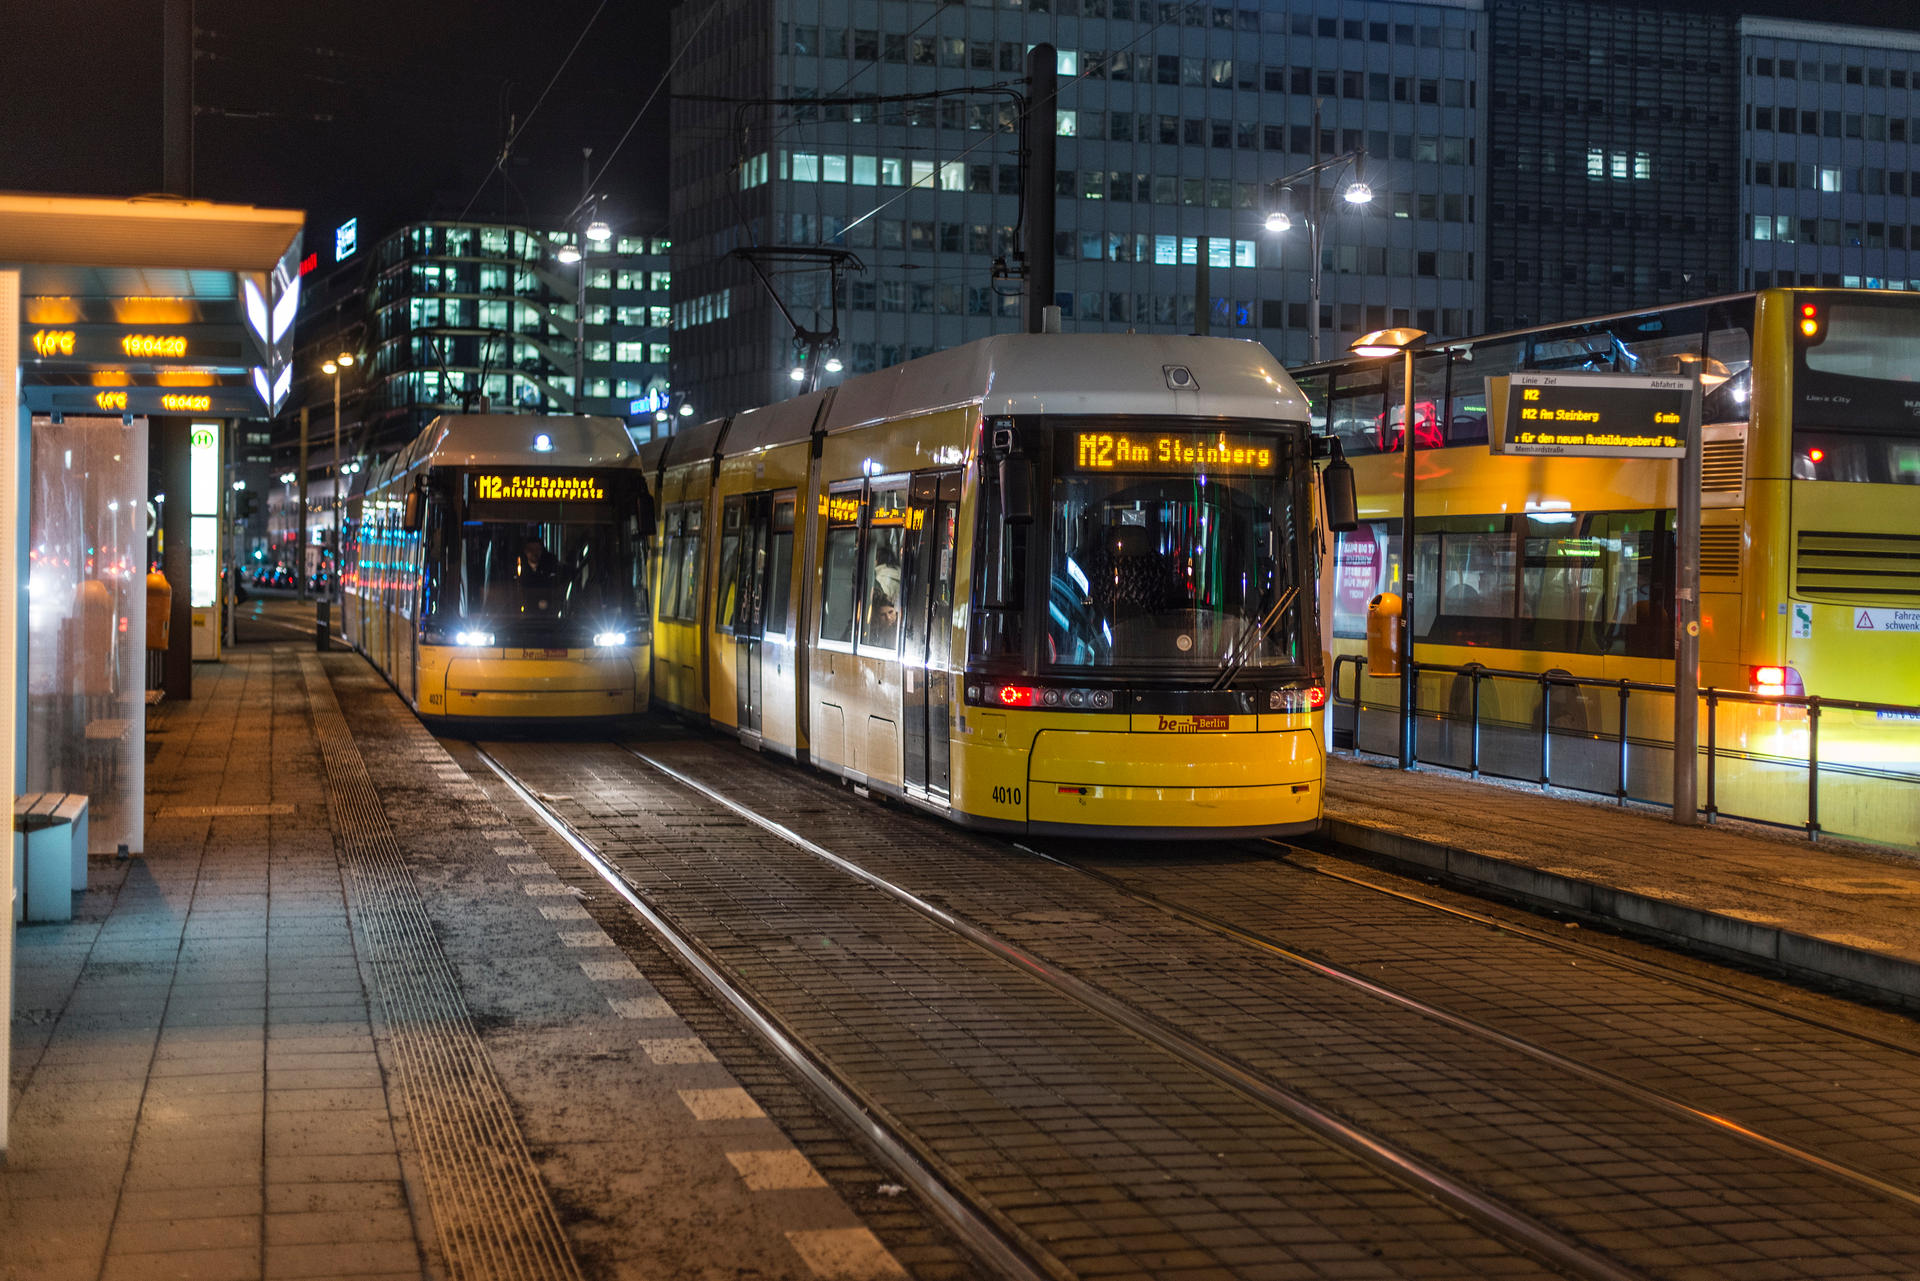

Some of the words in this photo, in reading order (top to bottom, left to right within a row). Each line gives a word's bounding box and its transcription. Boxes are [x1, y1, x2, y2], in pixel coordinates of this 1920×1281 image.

[122, 334, 188, 357] 19:04:20
[1522, 376, 1537, 384] Linie
[1544, 376, 1557, 385] Ziel
[1651, 381, 1676, 389] Abfahrt
[162, 393, 211, 411] 19:04:20
[1523, 389, 1541, 401] M2
[1521, 408, 1539, 420] M2
[1539, 408, 1555, 420] Am
[1555, 409, 1600, 423] Steinberg
[1653, 411, 1663, 423] 6
[1662, 412, 1680, 424] min
[1521, 432, 1536, 443] für
[1537, 432, 1555, 444] den
[1556, 435, 1584, 445] neuen
[1585, 433, 1663, 447] Ausbildungsberuf
[1079, 434, 1113, 467] M2
[1116, 437, 1150, 461] Am
[1158, 438, 1270, 467] Steinberg
[479, 475, 502, 499] M2
[502, 487, 603, 500] Alexanderplatz
[1885, 620, 1920, 630] schwenk
[1158, 715, 1177, 731] be
[1199, 718, 1226, 728] Berlin
[992, 785, 1021, 805] 4010
